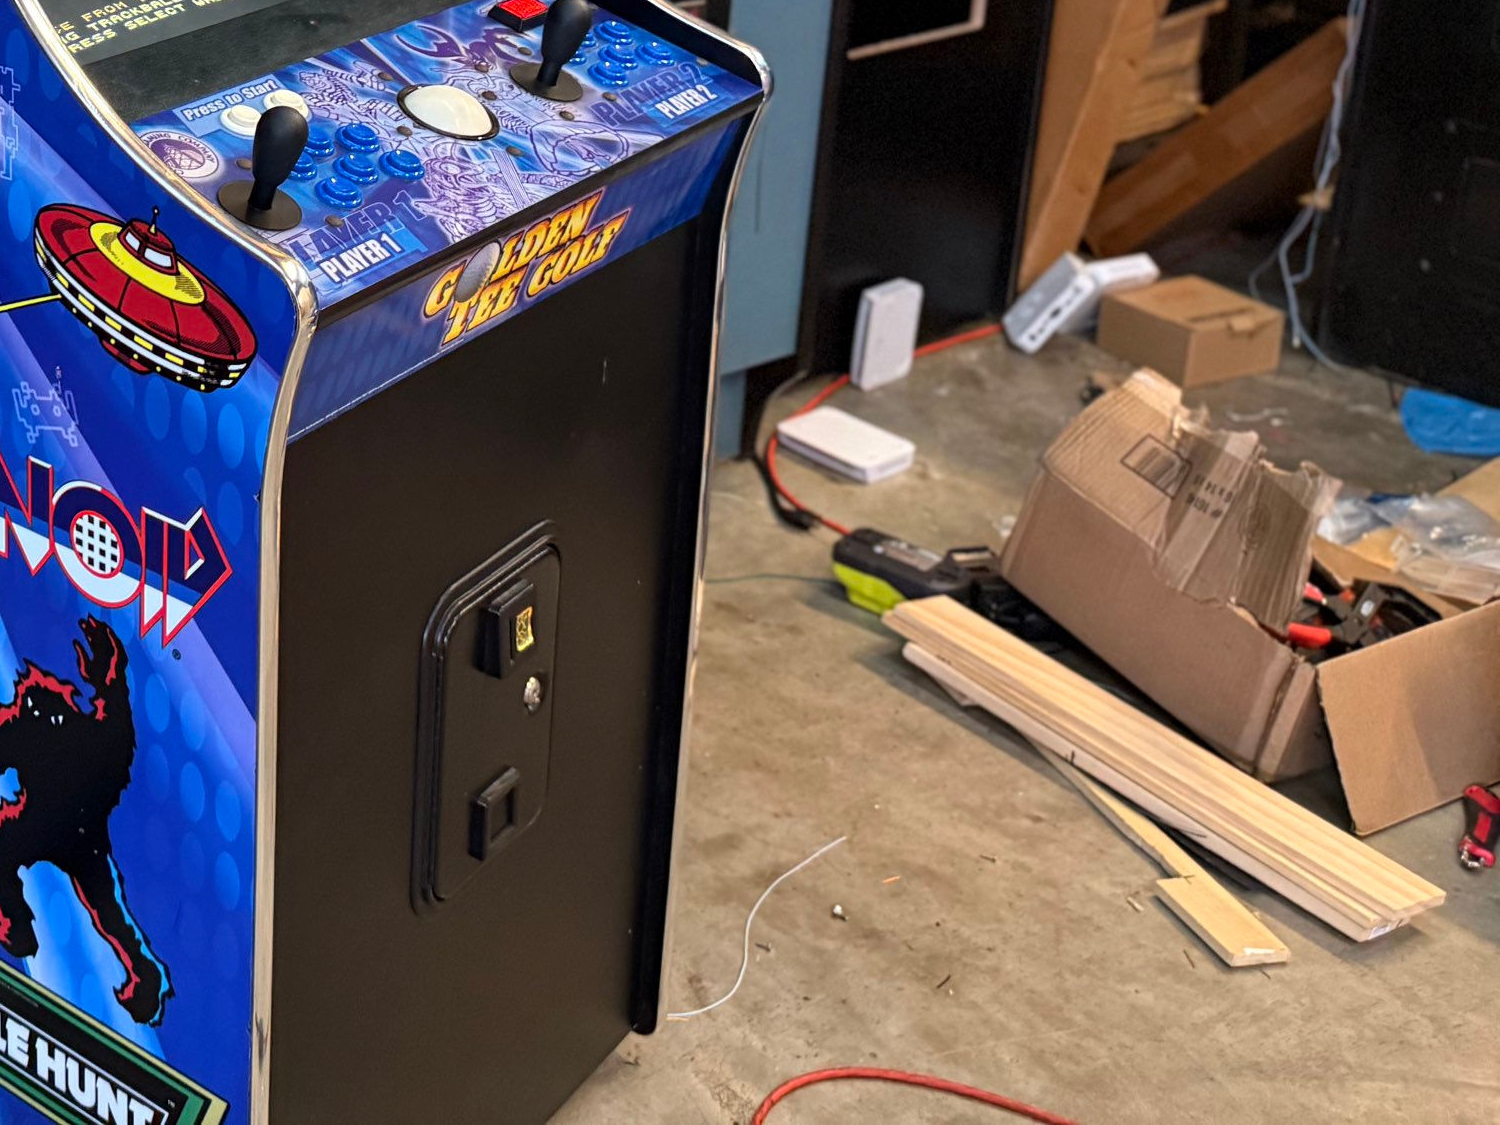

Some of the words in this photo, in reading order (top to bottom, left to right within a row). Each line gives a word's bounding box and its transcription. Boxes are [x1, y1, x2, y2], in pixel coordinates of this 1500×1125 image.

[68, 28, 117, 54] RESS
[124, 4, 187, 30] SELECT
[81, 1, 128, 22] FROM
[181, 98, 227, 121] Press
[223, 92, 243, 106] to
[240, 79, 279, 99] Start
[589, 70, 684, 127] PLAYER
[654, 88, 708, 120] PLAYER
[695, 84, 718, 101] 2
[288, 201, 405, 273] LAYER
[393, 190, 427, 221] 1
[319, 238, 392, 283] PLAYER
[379, 232, 403, 253] 1
[423, 188, 604, 319] GOLDEN
[440, 268, 527, 345] TEE
[527, 207, 633, 298] GOLF
[35, 1029, 155, 1125] HUNT
